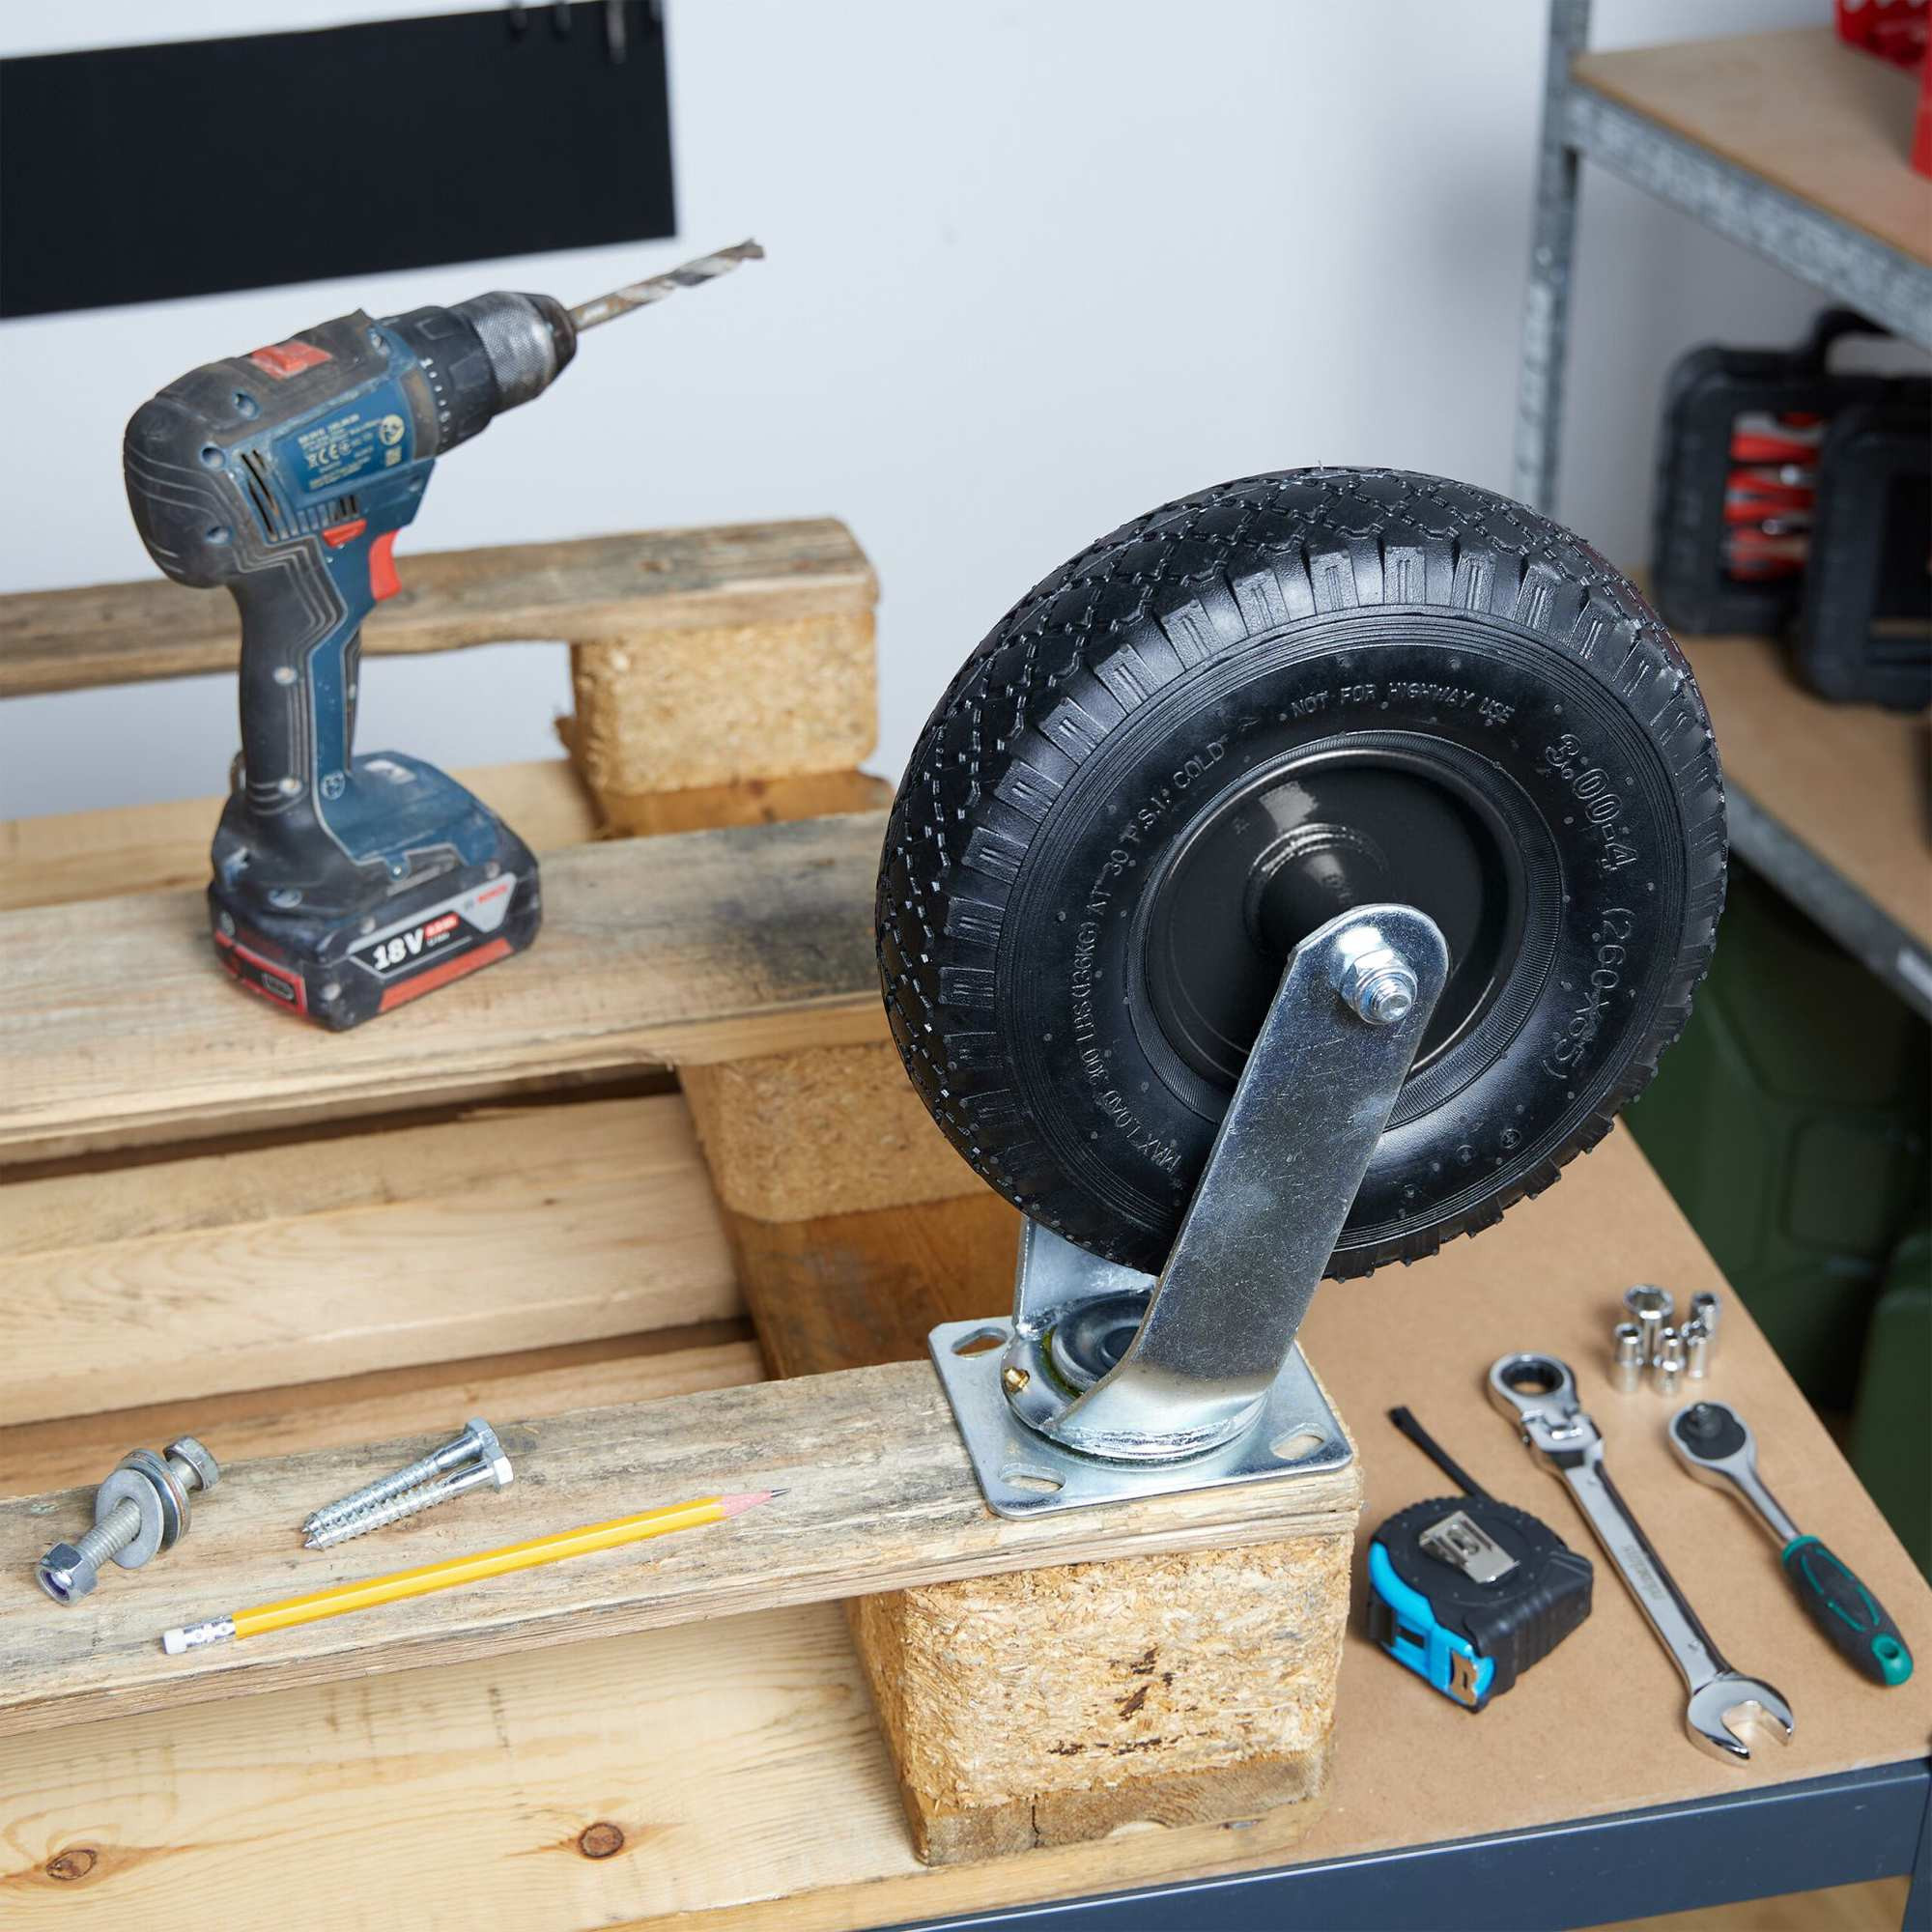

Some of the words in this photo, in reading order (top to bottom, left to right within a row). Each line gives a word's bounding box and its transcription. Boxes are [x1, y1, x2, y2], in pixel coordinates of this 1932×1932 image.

[1291, 689, 1329, 718] NOT
[1340, 684, 1377, 705] FOR
[1388, 681, 1476, 708] HIGHWAY
[1086, 888, 1113, 917] AT
[1103, 848, 1130, 877] 30
[1172, 740, 1226, 790] COLD
[1545, 732, 1639, 873] 3.00-4
[373, 928, 424, 970] 18V
